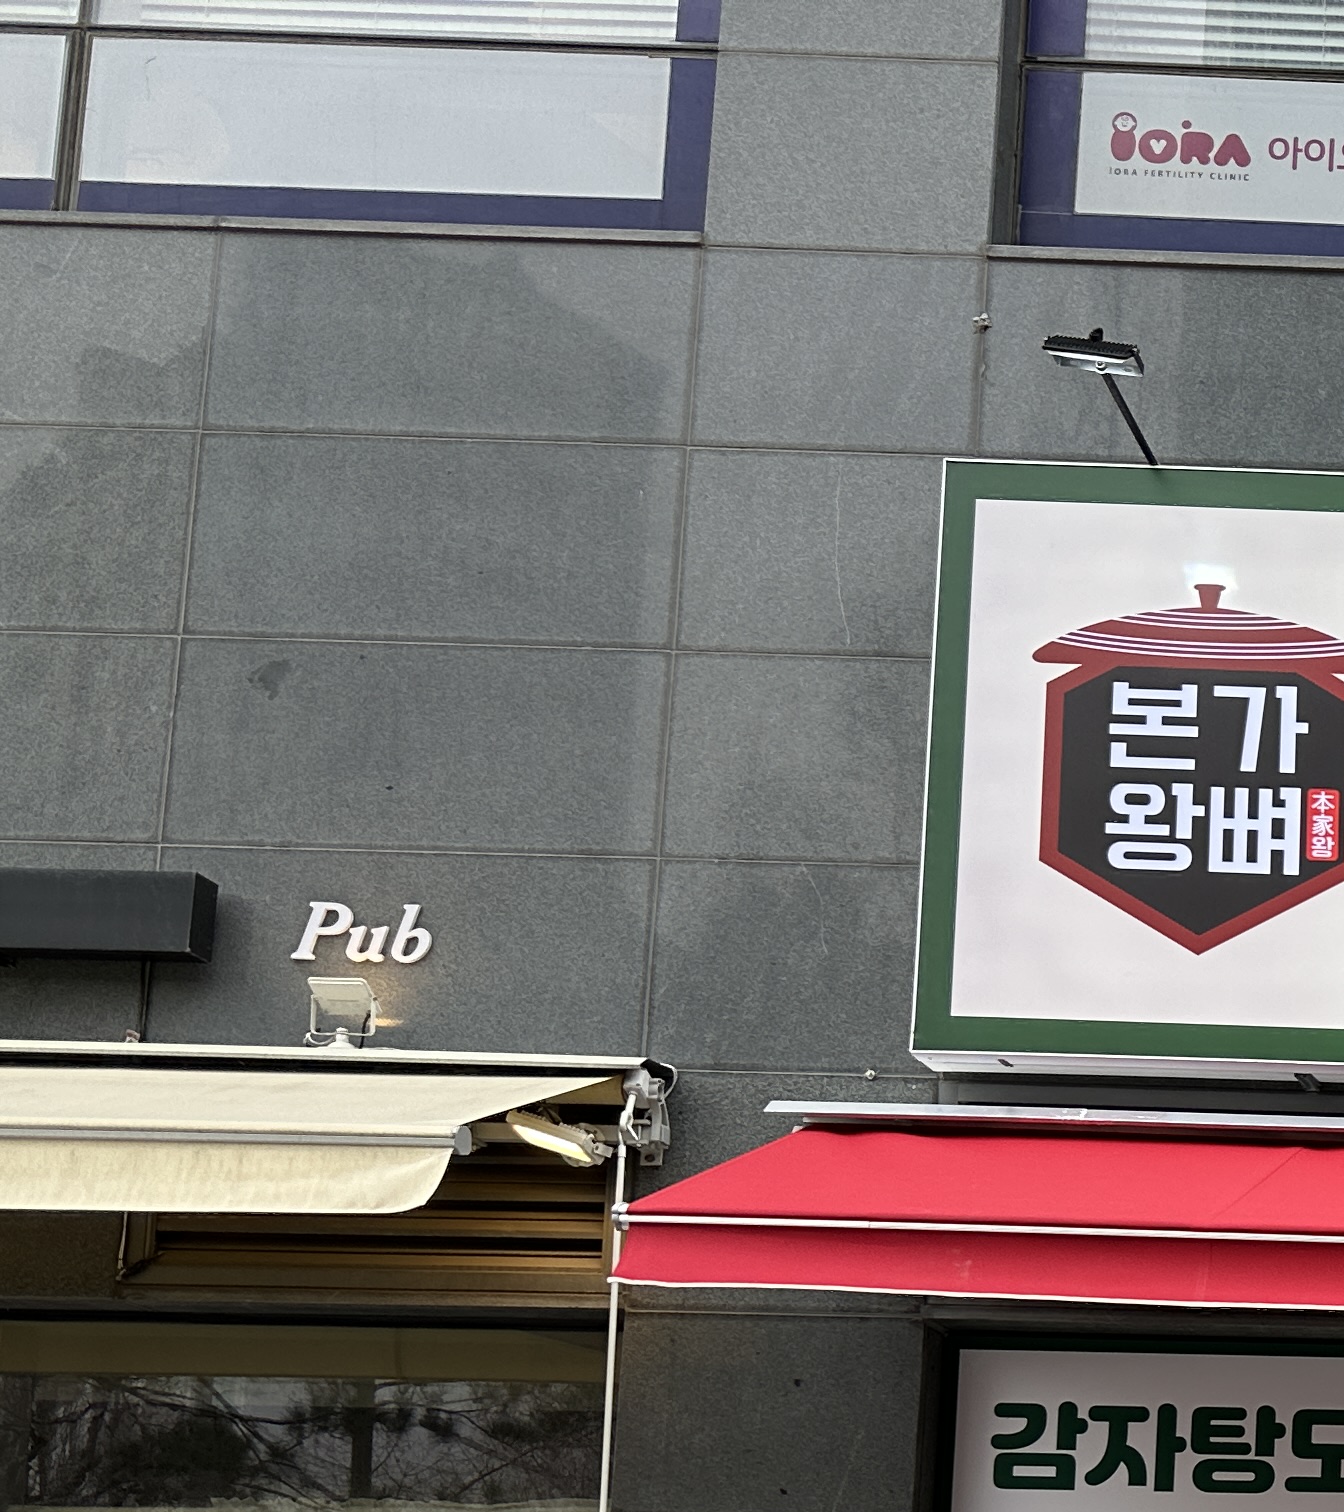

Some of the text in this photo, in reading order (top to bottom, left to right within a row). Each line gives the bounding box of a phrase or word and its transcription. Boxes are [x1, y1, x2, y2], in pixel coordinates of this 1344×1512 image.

[1209, 172, 1250, 182] CLINIC
[1108, 680, 1311, 774] 본가
[1104, 782, 1302, 877] 왕뼈
[291, 901, 433, 964] Pub
